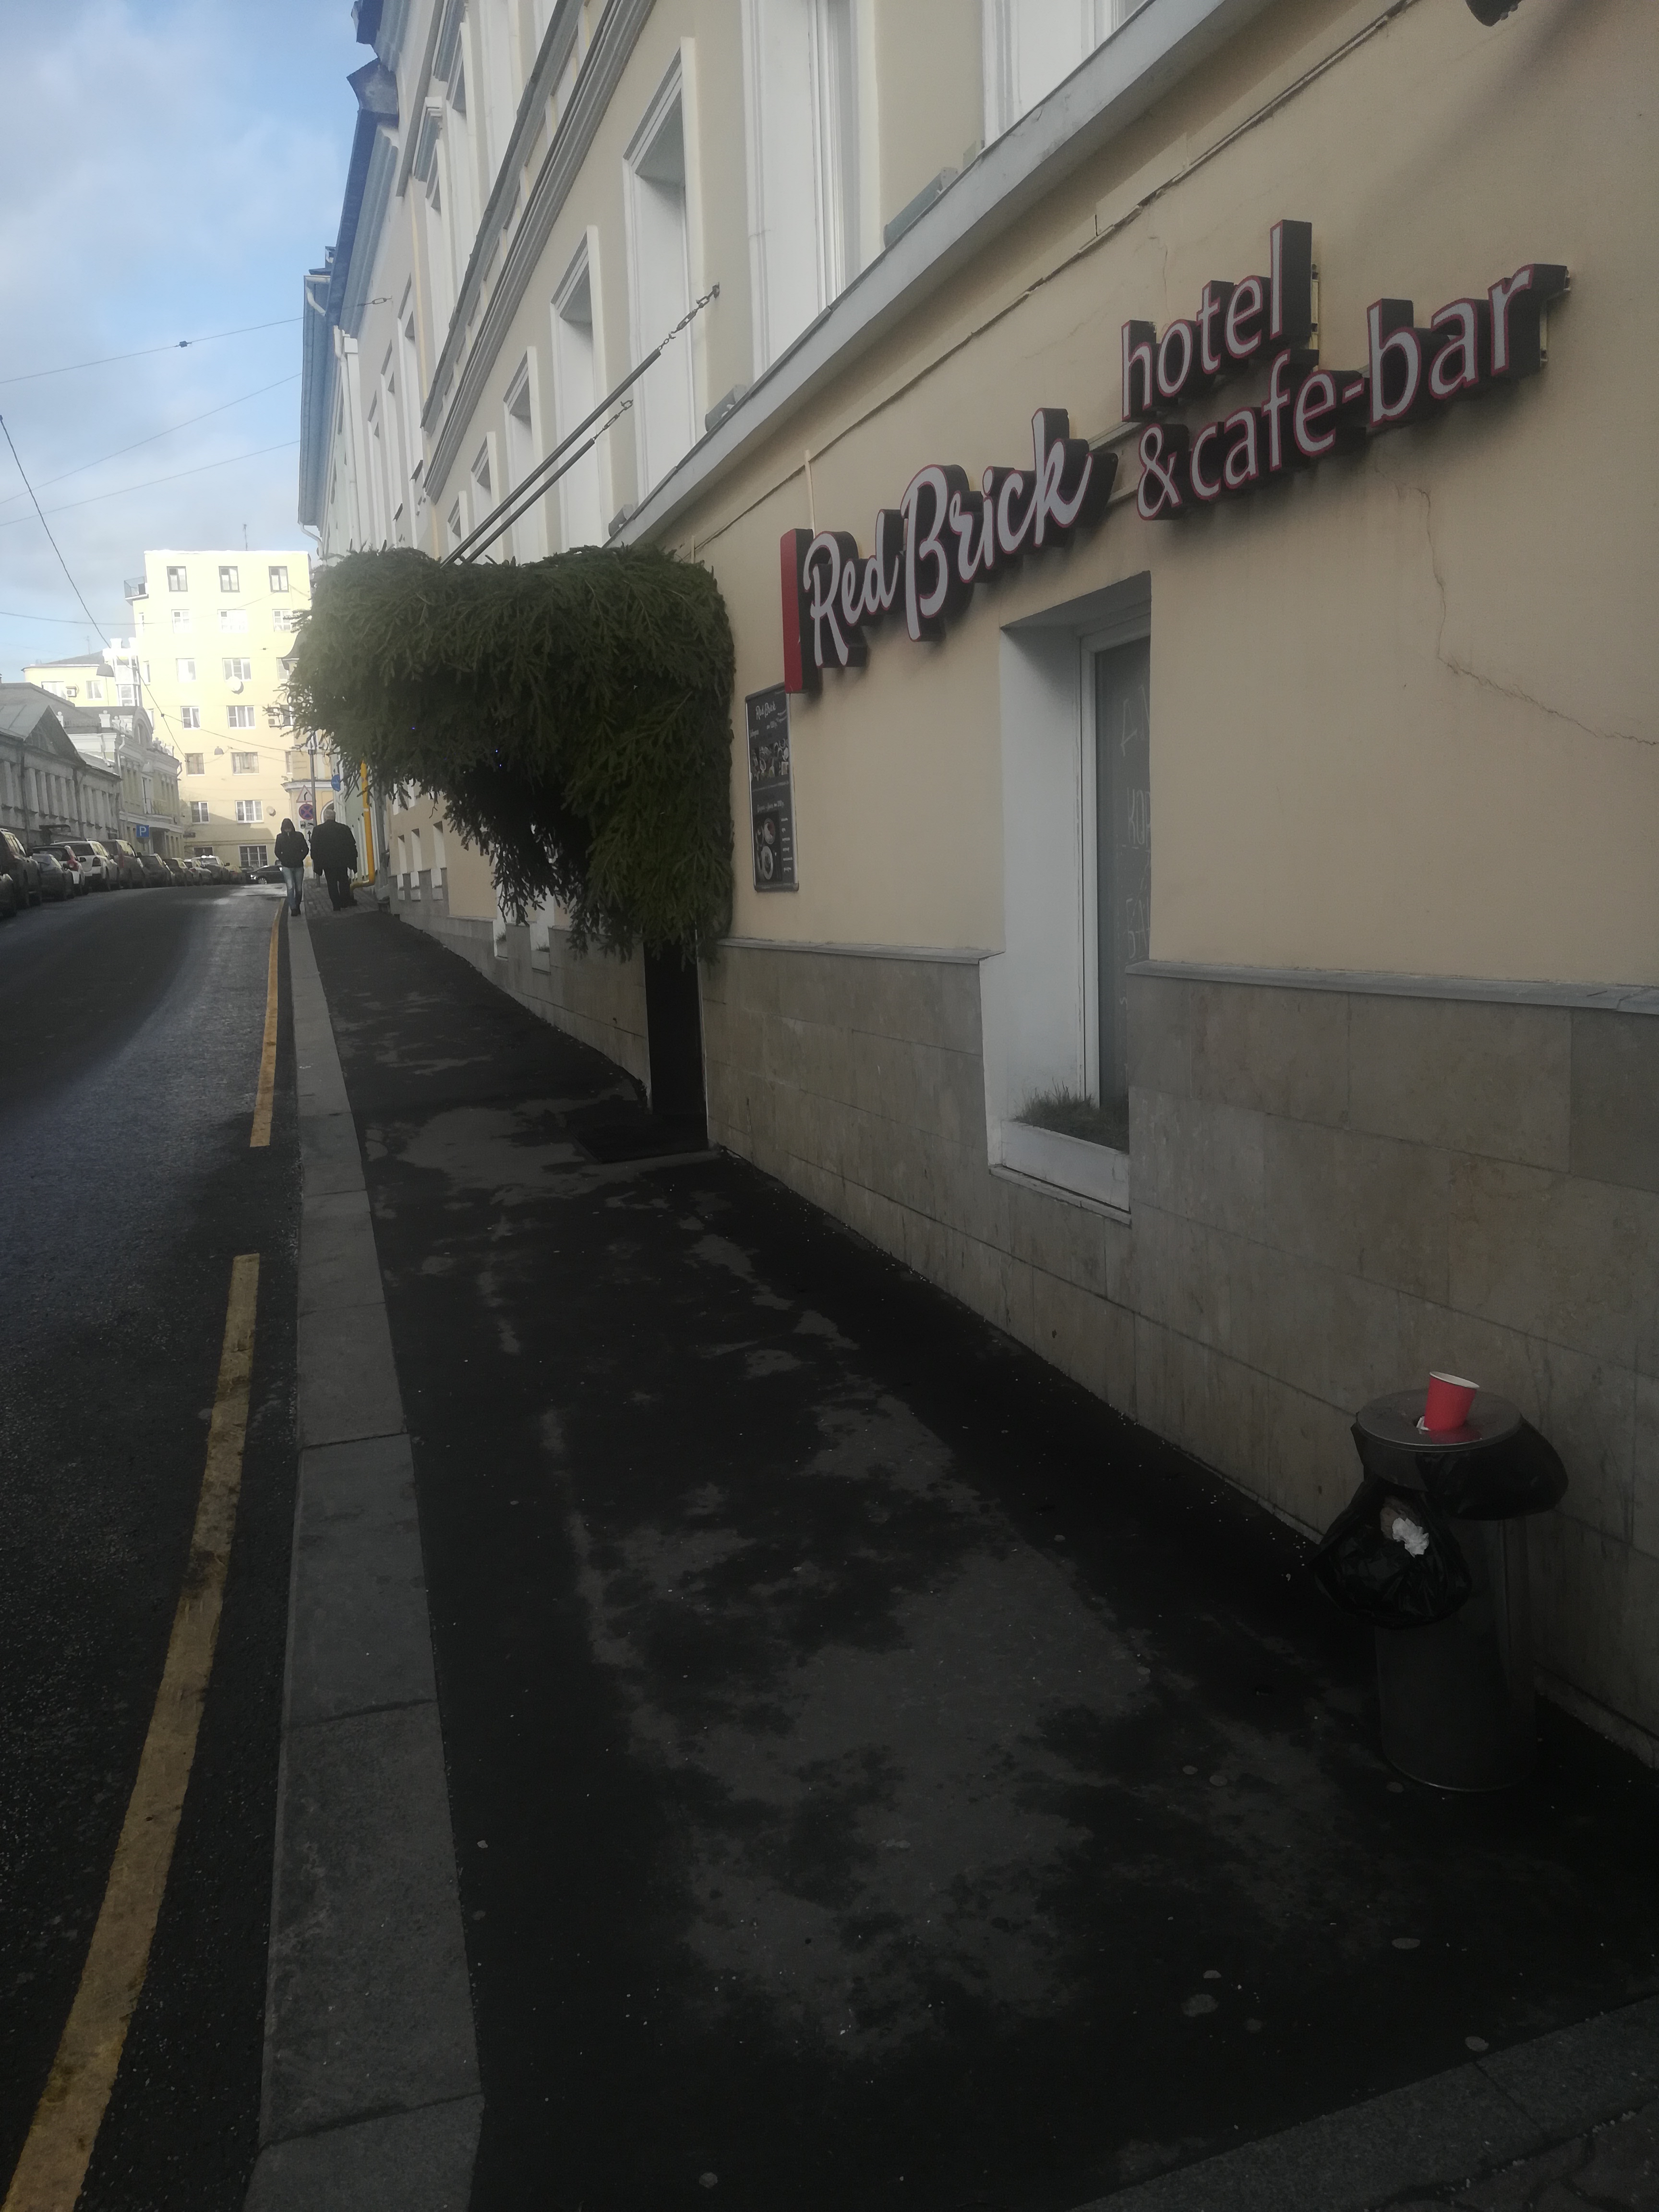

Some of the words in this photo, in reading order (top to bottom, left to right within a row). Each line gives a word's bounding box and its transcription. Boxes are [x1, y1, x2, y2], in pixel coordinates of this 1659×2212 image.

[1121, 221, 1285, 422] hotel
[1136, 423, 1181, 521] &
[1188, 264, 1536, 502] cafe-bar
